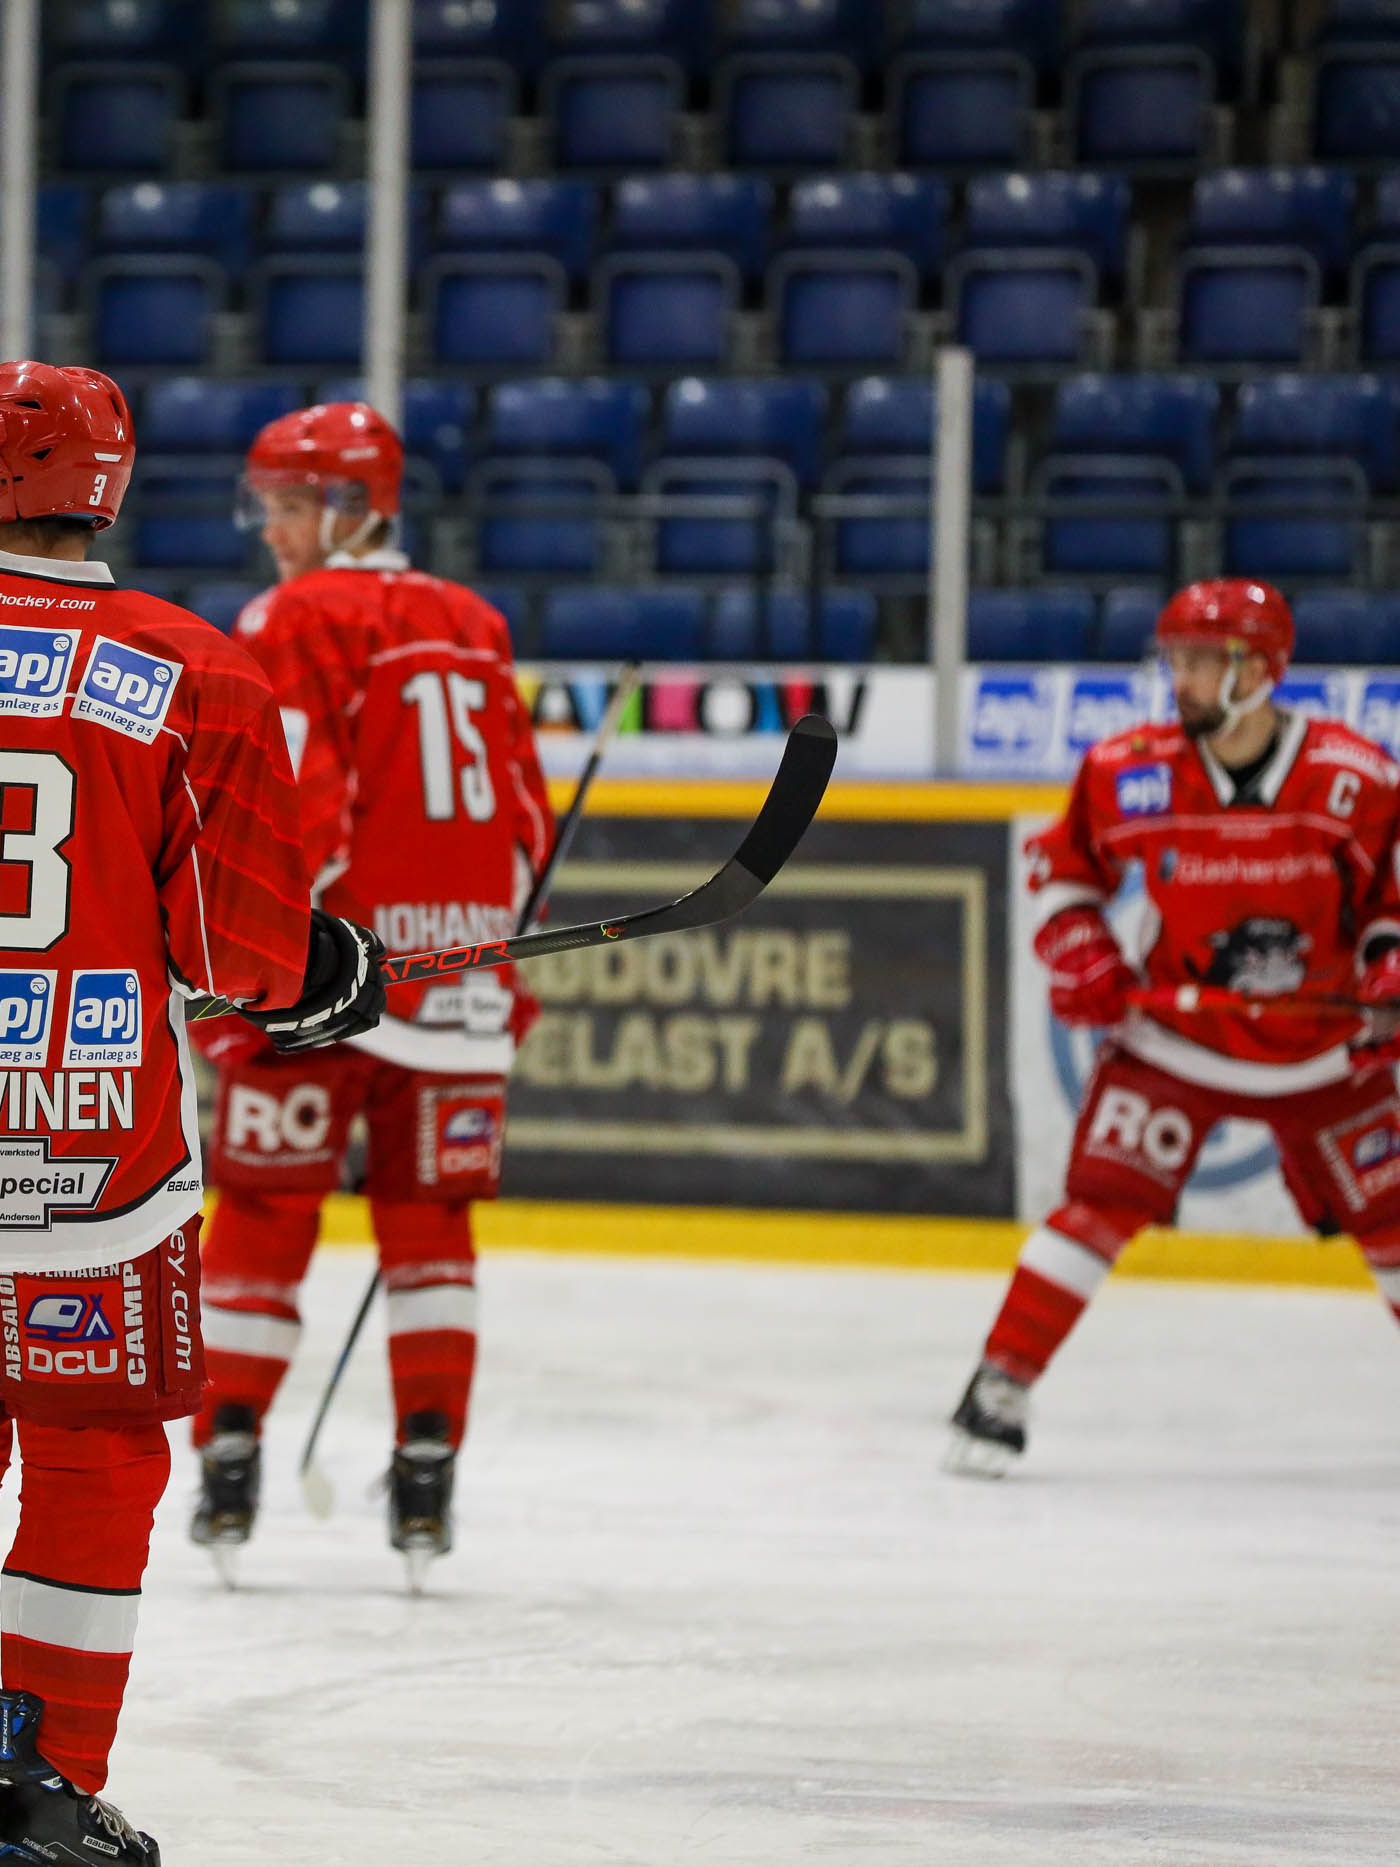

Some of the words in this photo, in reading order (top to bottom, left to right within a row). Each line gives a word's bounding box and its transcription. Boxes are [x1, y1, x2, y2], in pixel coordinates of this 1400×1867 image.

[89, 474, 107, 506] 3
[91, 660, 169, 715] apj
[78, 700, 136, 732] El-anlæg
[401, 671, 497, 822] 15
[1327, 769, 1361, 818] C
[75, 977, 137, 1040] apj
[69, 1049, 124, 1063] El-anlæg
[780, 1016, 939, 1104] A/S
[227, 1084, 331, 1150] RC
[0, 1212, 41, 1222] Andersen
[123, 1263, 147, 1386] CAMP
[27, 1346, 118, 1375] DCU
[86, 1837, 117, 1853] BAUER
